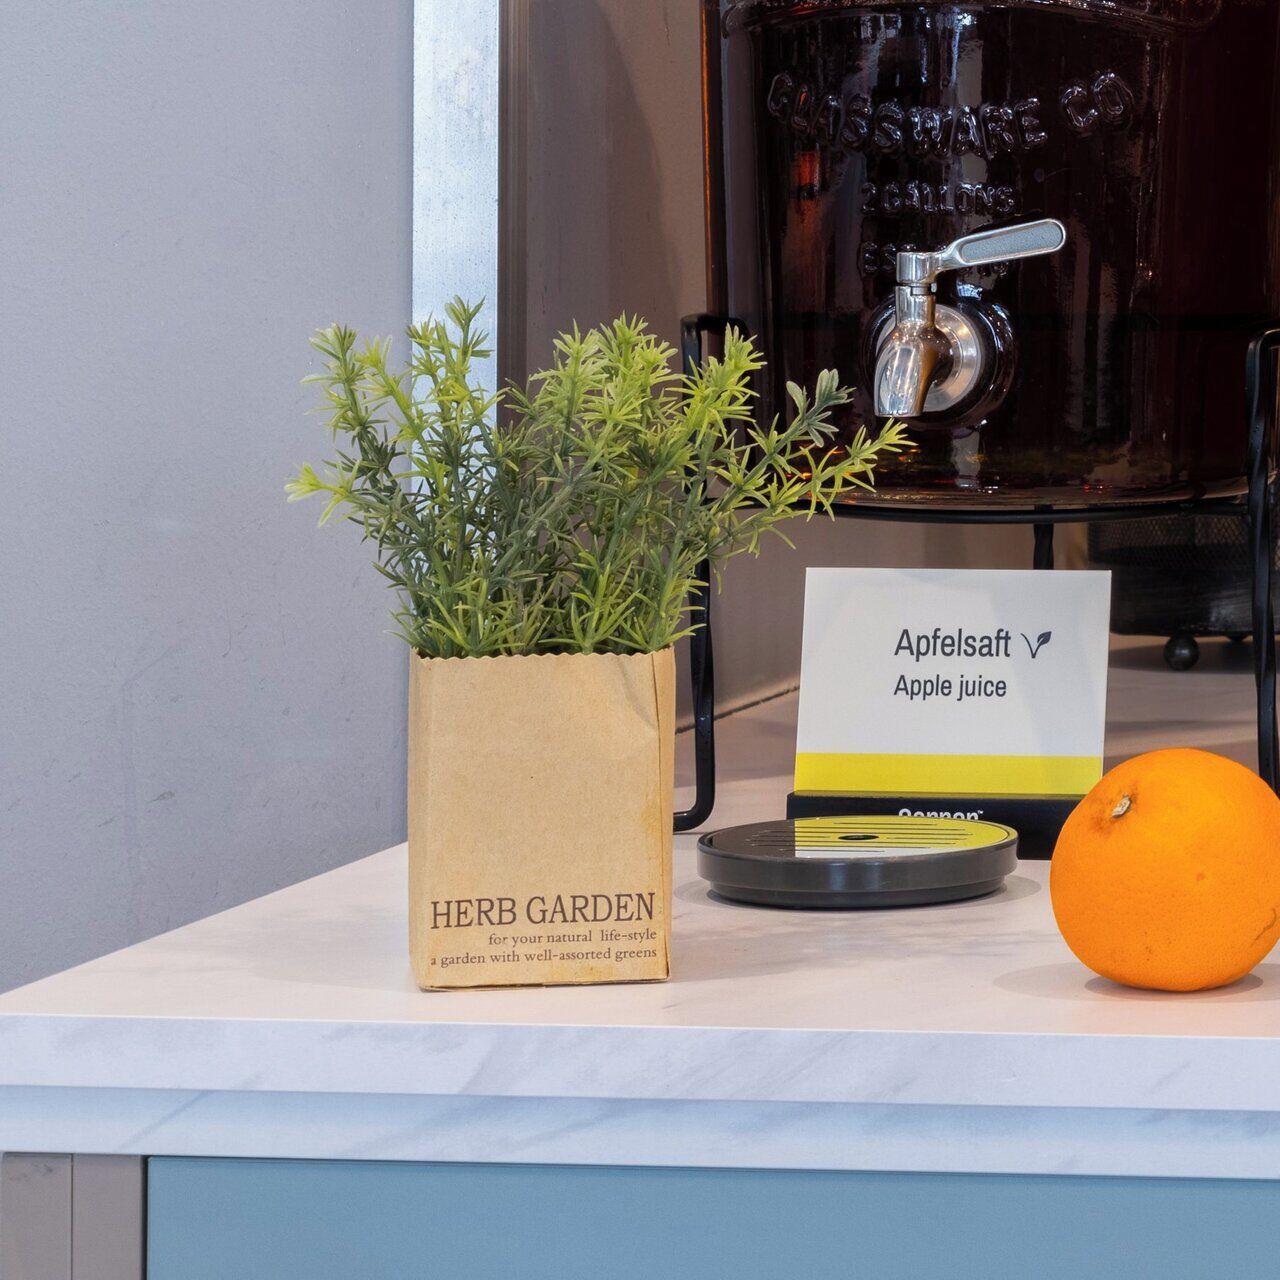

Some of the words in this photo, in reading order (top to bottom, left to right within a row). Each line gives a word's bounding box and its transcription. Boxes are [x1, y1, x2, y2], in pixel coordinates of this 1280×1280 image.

[894, 628, 1011, 662] Apfelsaft
[893, 674, 953, 701] Apple
[956, 674, 1008, 701] juice
[430, 897, 517, 929] HERB
[526, 892, 656, 924] GARDEN
[488, 933, 507, 946] for
[512, 935, 543, 948] your
[547, 930, 592, 944] natural
[600, 928, 657, 944] life-style
[430, 957, 437, 965] a
[440, 952, 485, 968] garden
[490, 949, 520, 963] with
[524, 948, 611, 962] well-assorted
[615, 948, 657, 963] greens
